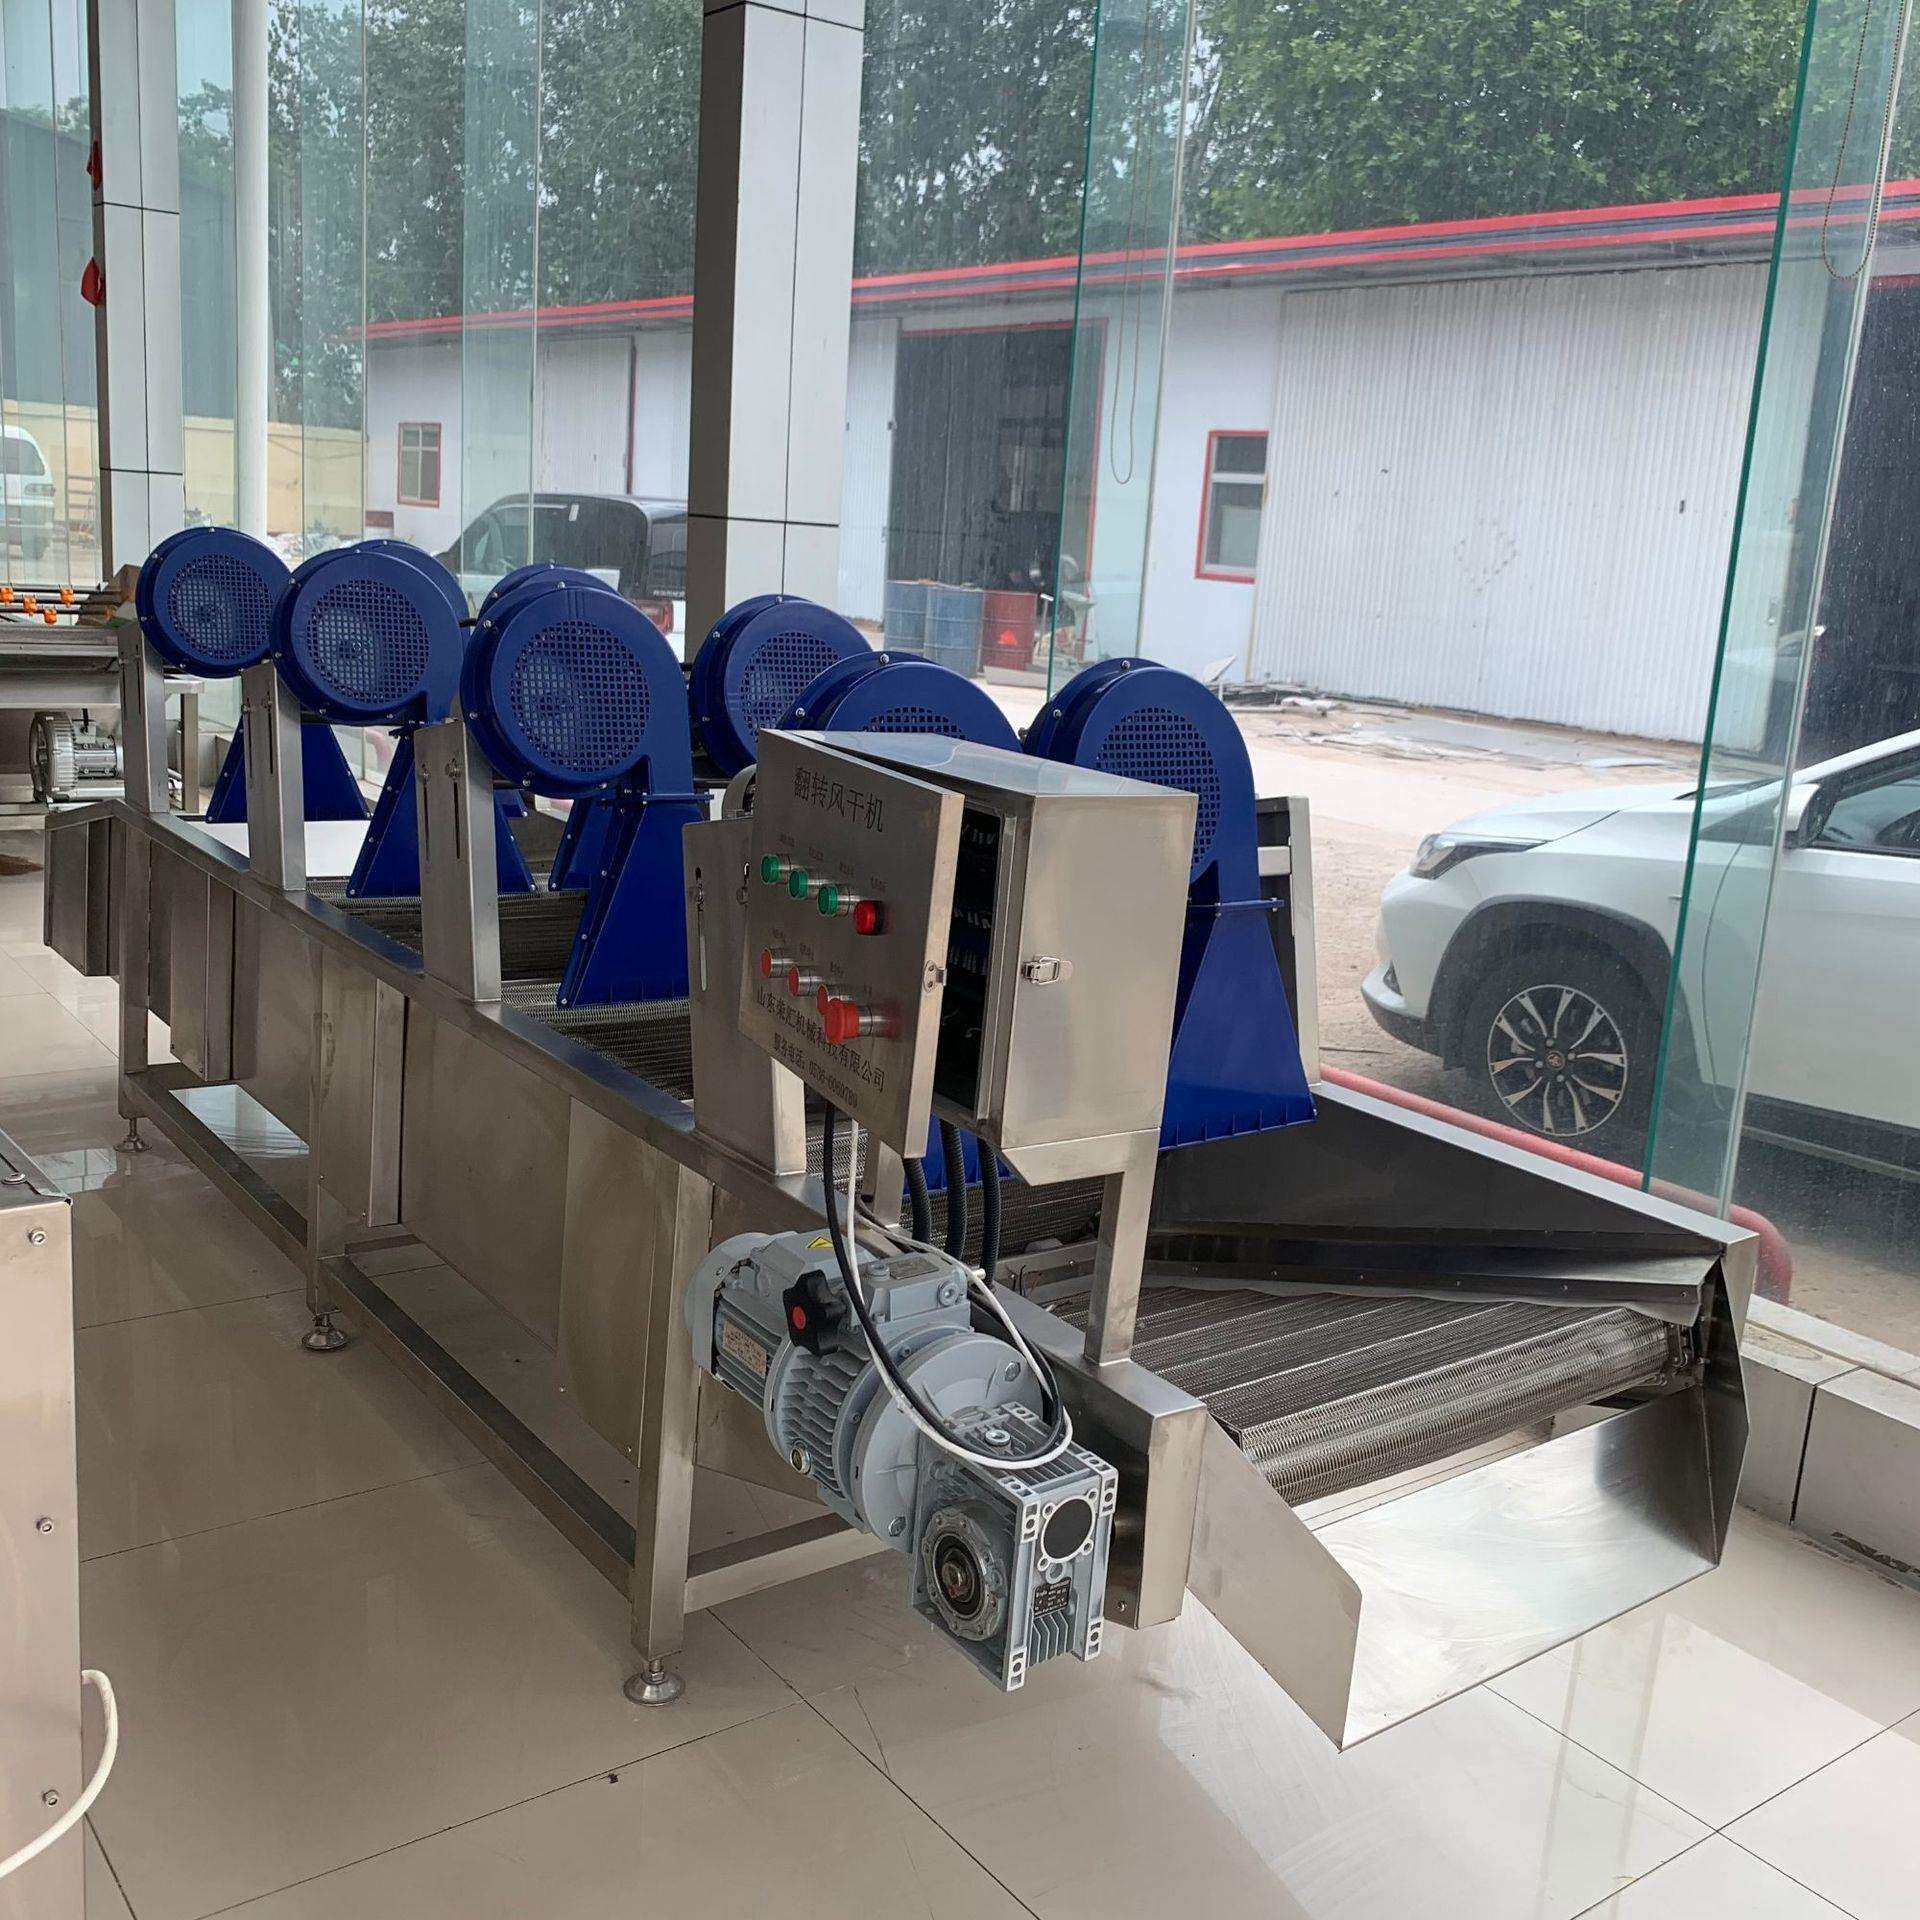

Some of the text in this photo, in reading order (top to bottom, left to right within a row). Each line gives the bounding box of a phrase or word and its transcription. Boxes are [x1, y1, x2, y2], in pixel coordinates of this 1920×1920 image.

[794, 767, 883, 832] 翻转风干机
